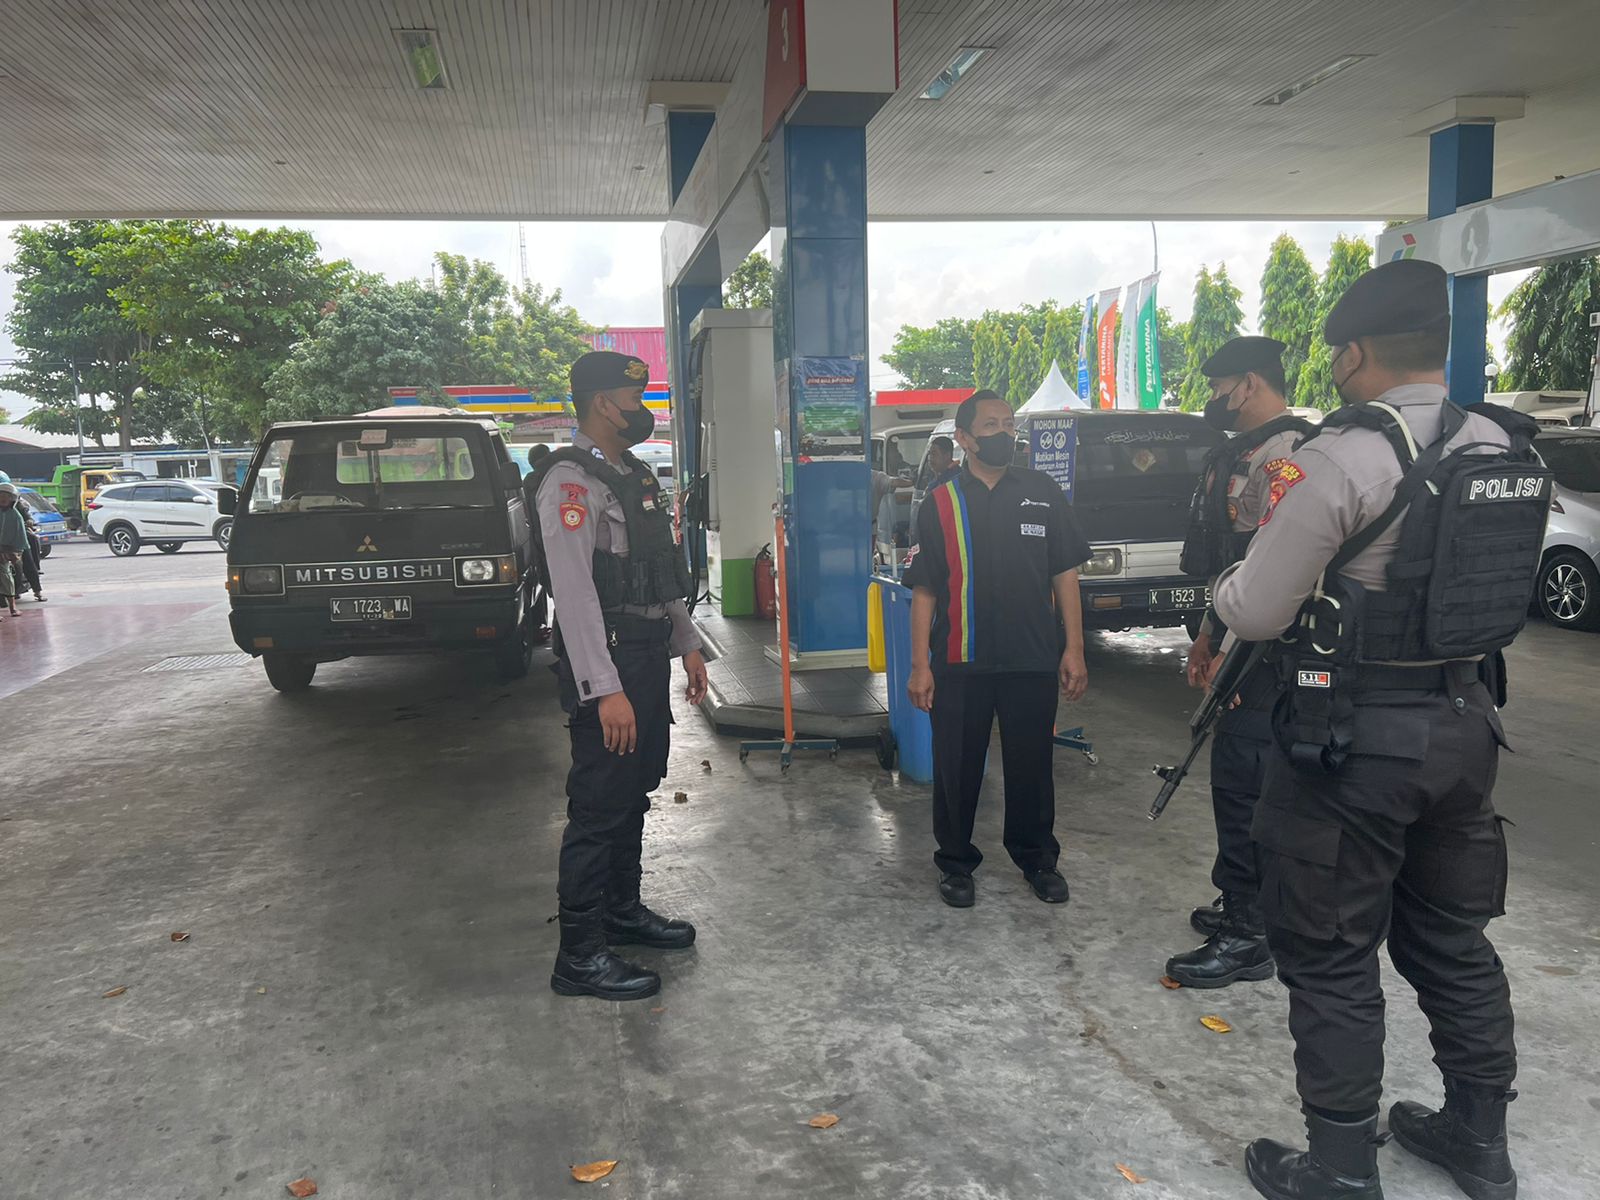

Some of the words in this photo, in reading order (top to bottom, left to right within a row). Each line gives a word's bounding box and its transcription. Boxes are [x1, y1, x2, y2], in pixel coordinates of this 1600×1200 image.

[781, 7, 789, 61] 3
[1144, 319, 1153, 392] PERTAMINA
[1034, 420, 1056, 430] MOHON
[1057, 419, 1073, 430] MAAF
[1469, 478, 1543, 500] POLISI
[296, 564, 442, 583] MITSUBISHI
[332, 601, 340, 614] K
[354, 599, 381, 613] 1723
[394, 598, 409, 612] WA
[1151, 591, 1158, 604] K
[1171, 589, 1195, 603] 1523
